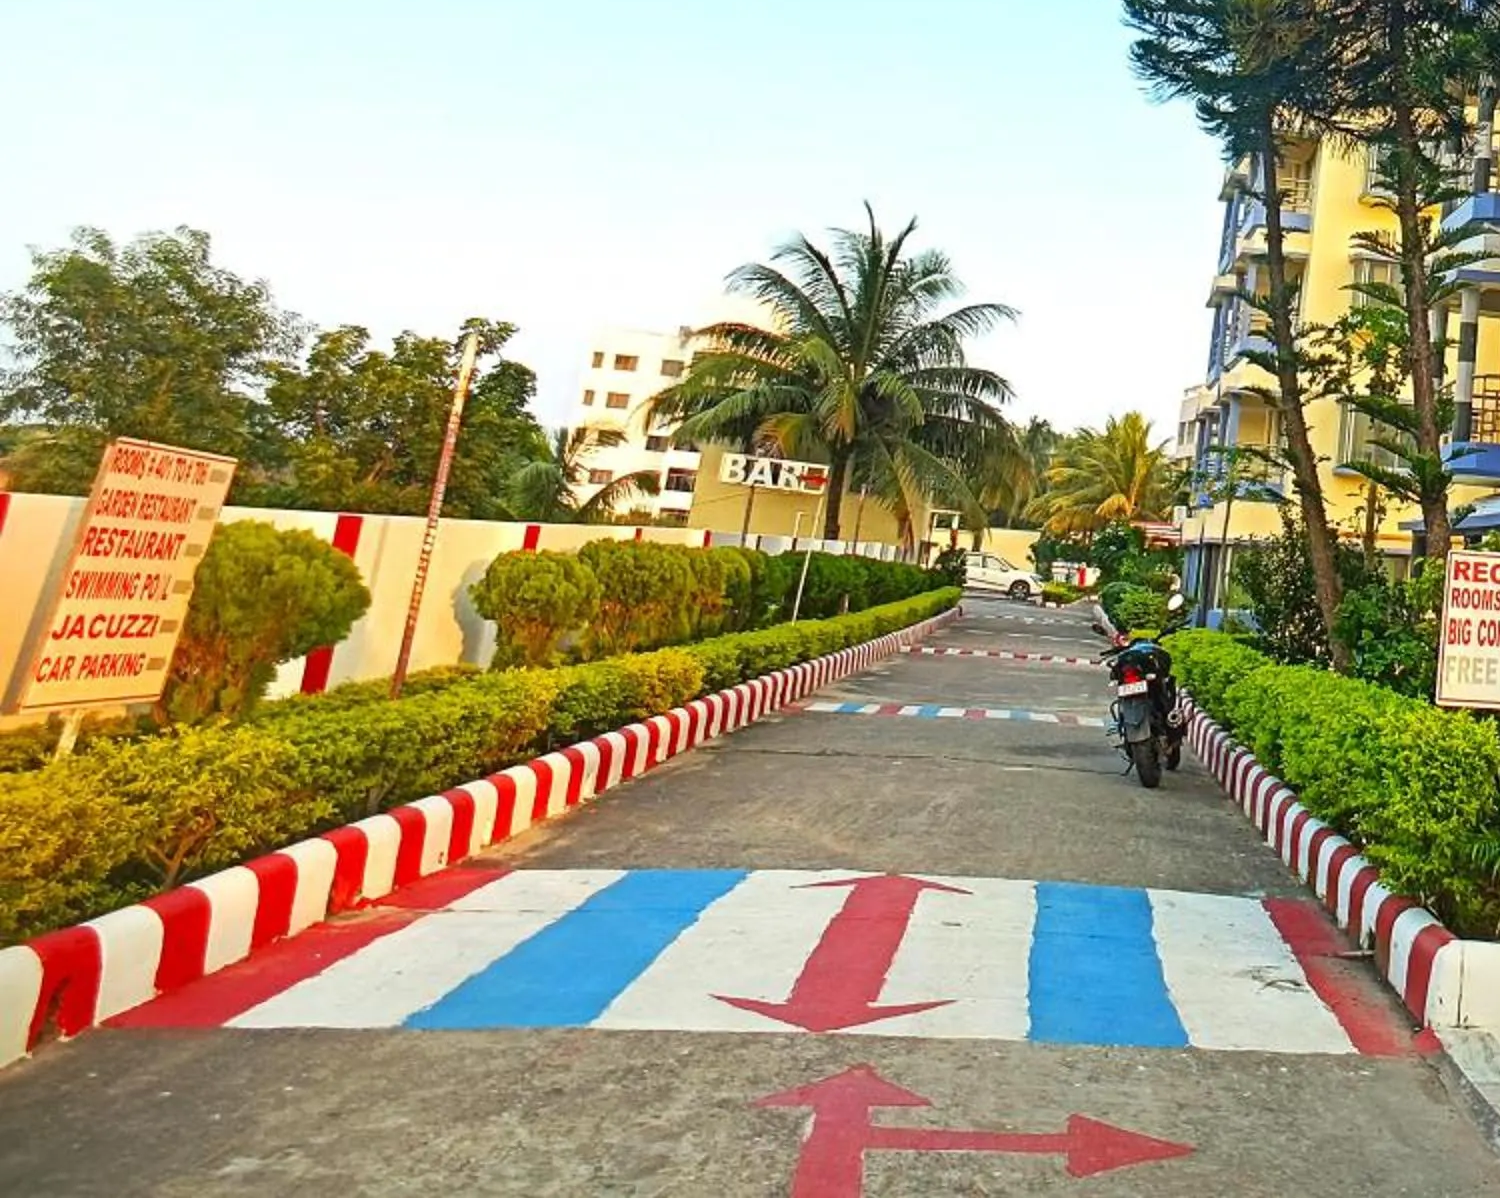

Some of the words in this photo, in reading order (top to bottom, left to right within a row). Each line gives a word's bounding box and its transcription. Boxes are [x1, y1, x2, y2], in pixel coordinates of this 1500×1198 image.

[720, 451, 801, 491] BAR
[95, 487, 140, 520] GARDEN
[137, 492, 198, 524] RESTAURANT
[80, 526, 187, 561] RESTAURANT
[65, 569, 142, 601] SWIMMING
[52, 614, 161, 640] JACUZZI
[1447, 617, 1472, 646] BIG
[36, 657, 73, 683] CAR
[78, 653, 147, 680] PARKING
[1445, 655, 1499, 686] FREE
